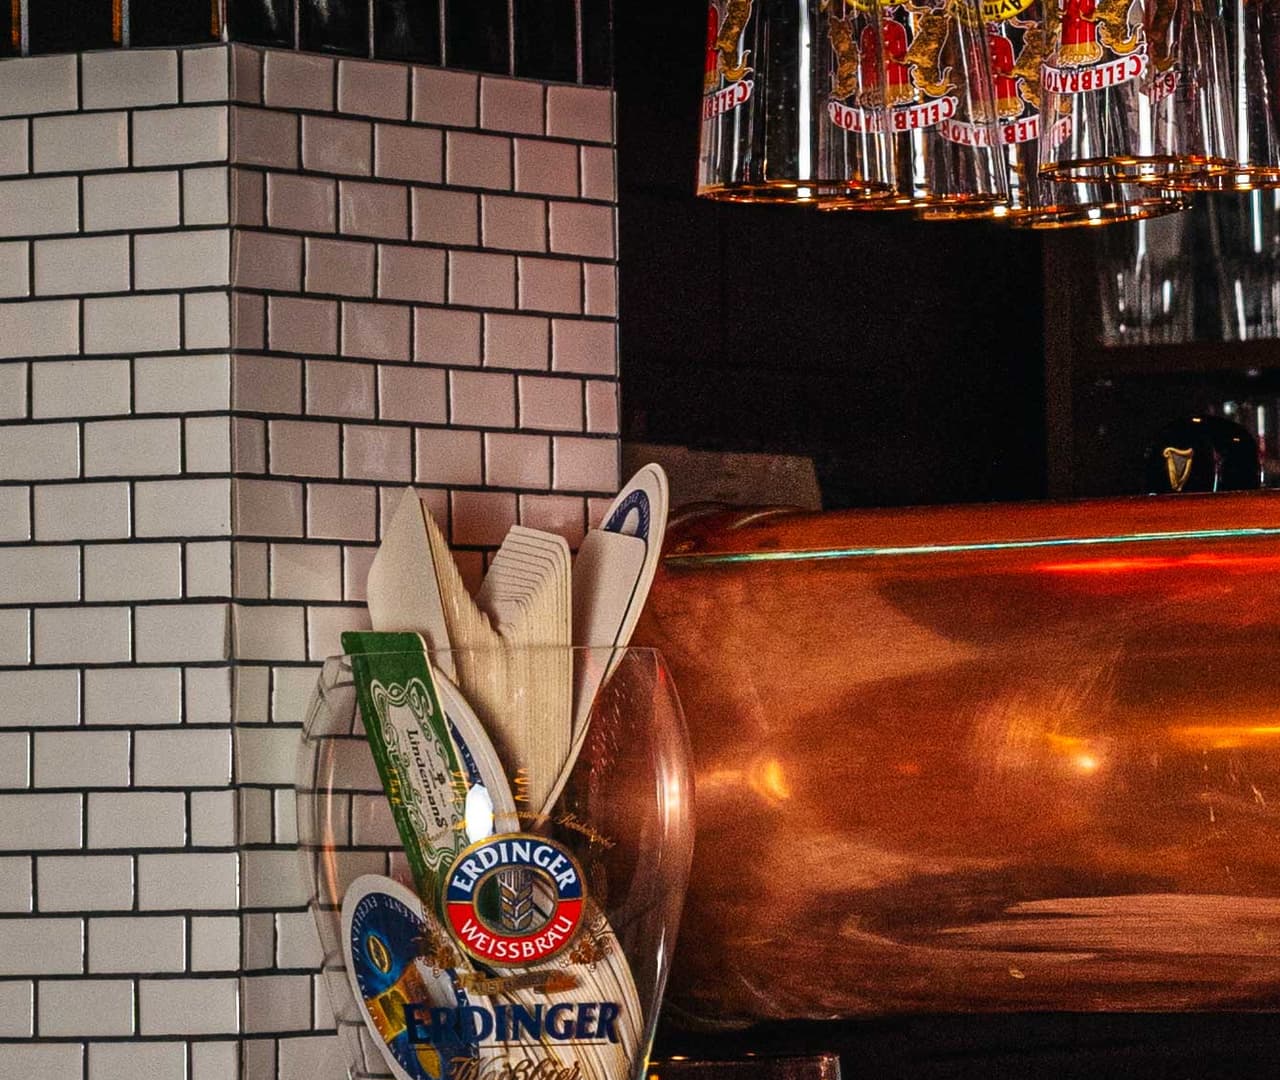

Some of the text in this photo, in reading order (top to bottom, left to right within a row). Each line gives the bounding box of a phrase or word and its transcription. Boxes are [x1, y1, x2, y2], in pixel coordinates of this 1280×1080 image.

[1042, 55, 1142, 94] CELEBRATO
[451, 841, 578, 894] ERDINGER
[459, 915, 575, 959] WEISSBRÄU
[403, 1001, 624, 1045] ERDINGER
